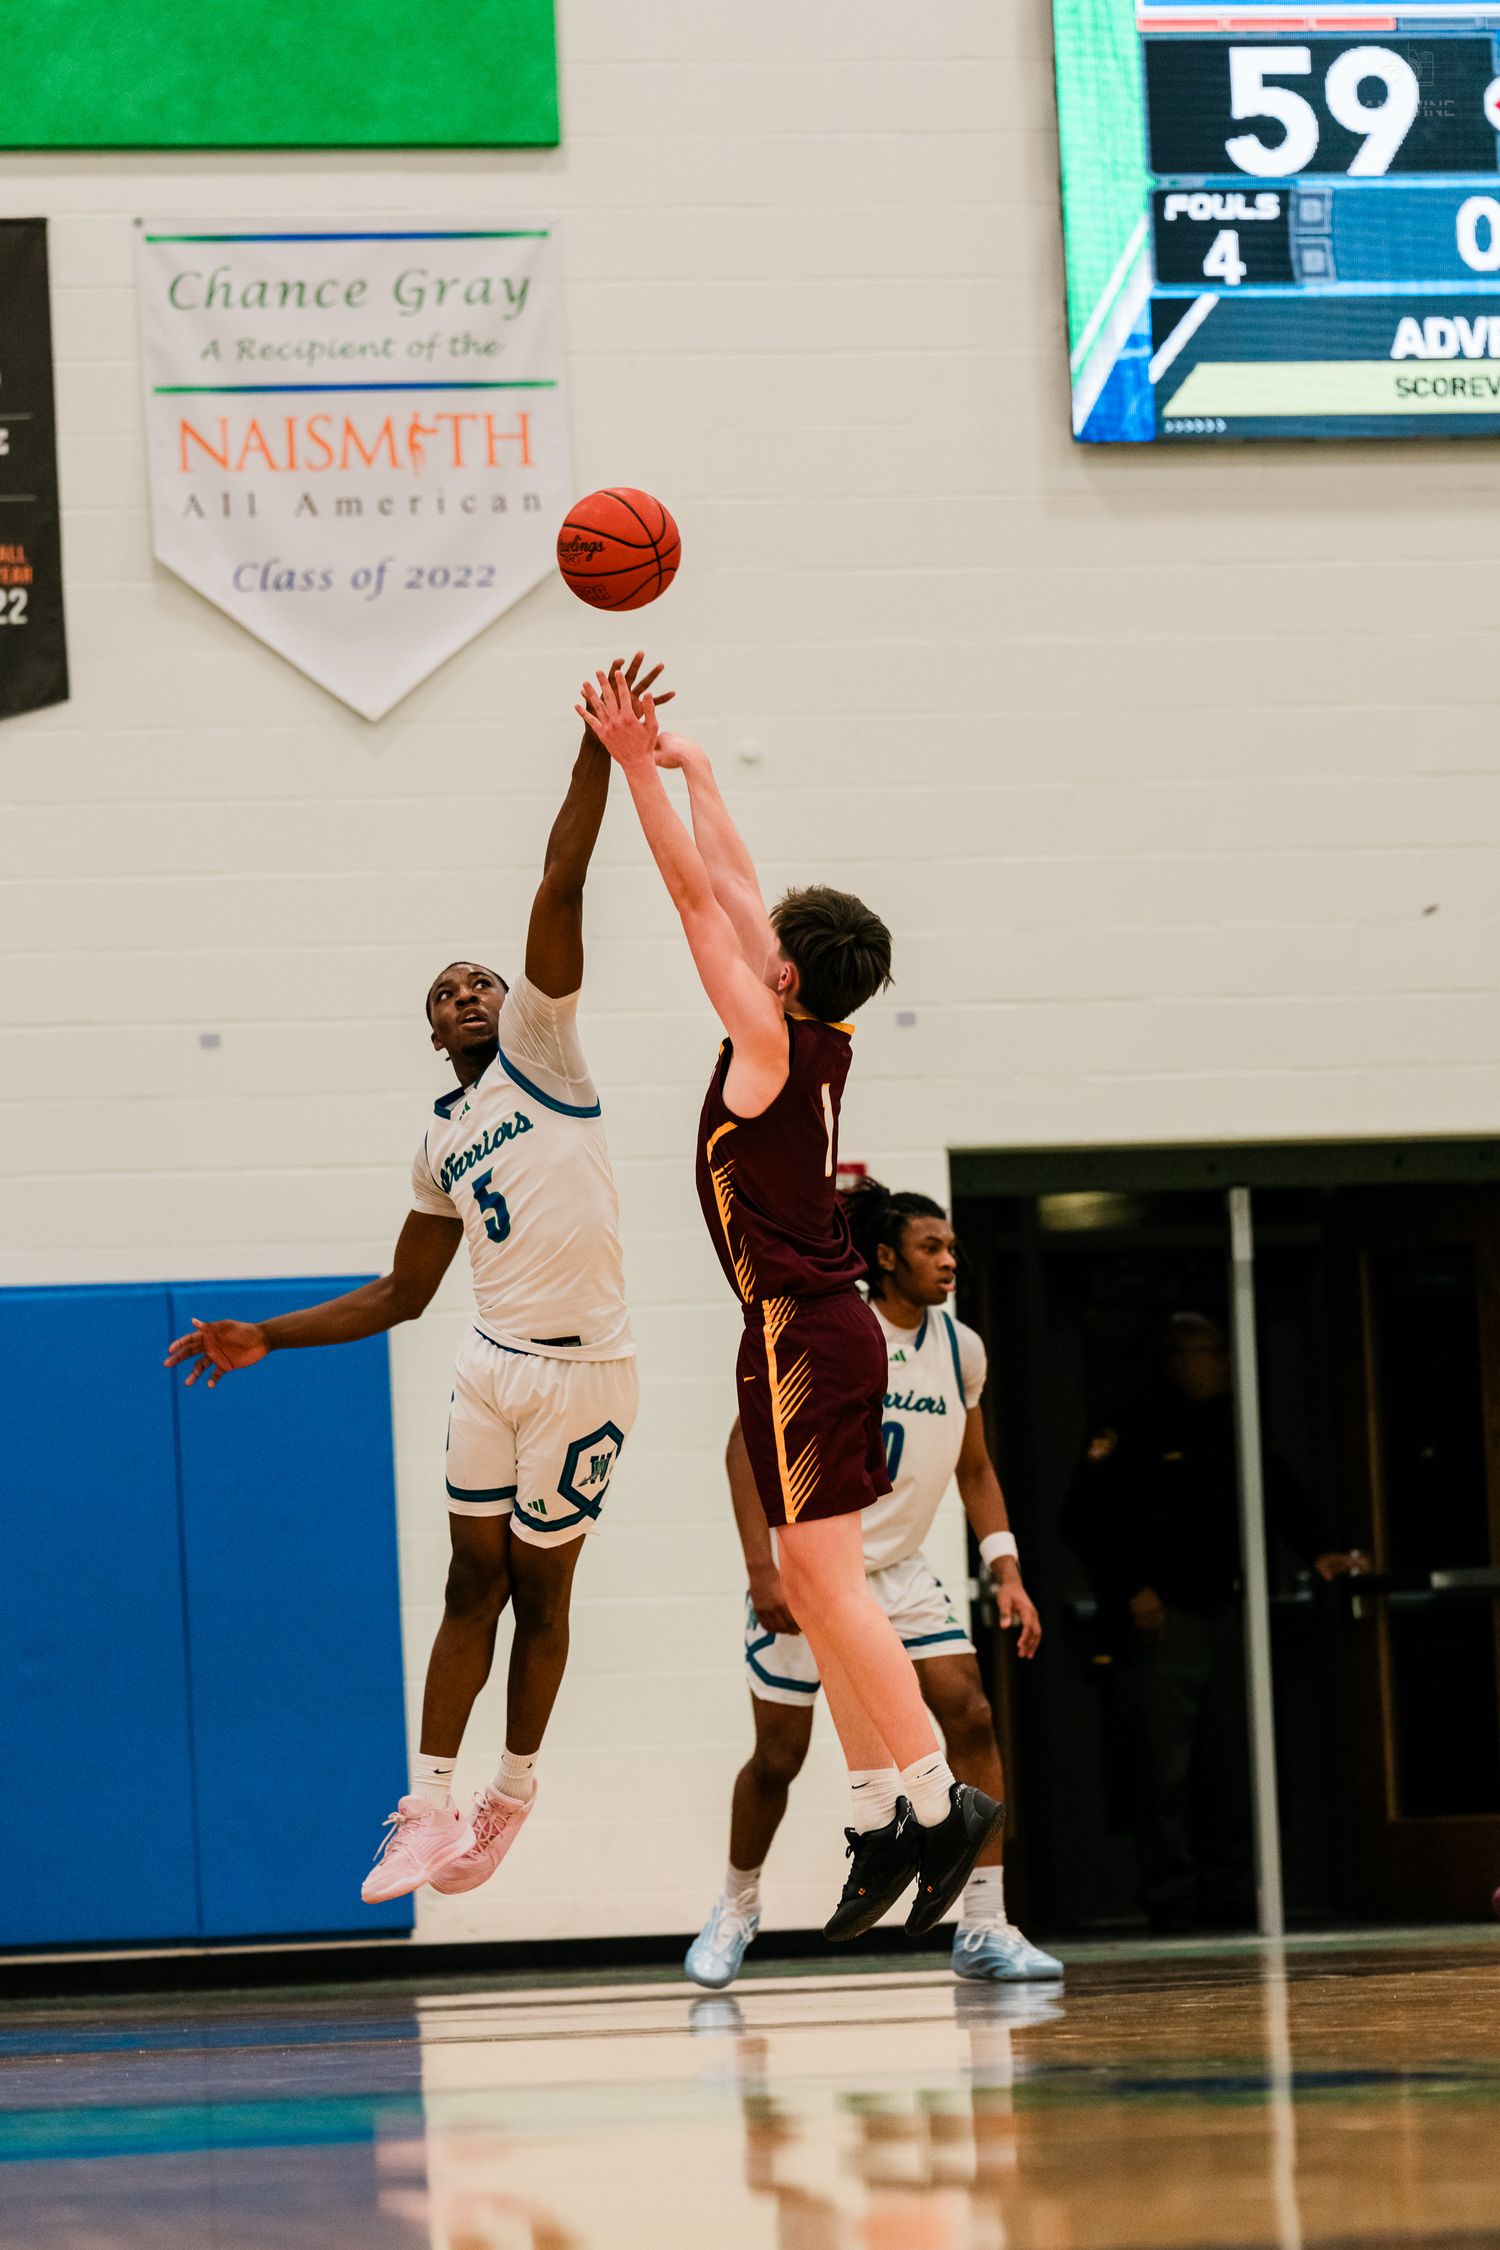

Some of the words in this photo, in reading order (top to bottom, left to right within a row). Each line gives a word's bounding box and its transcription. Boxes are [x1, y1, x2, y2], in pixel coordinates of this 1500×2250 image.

[1225, 45, 1420, 177] 59
[1163, 194, 1281, 221] FOULS
[1202, 229, 1248, 286] 4
[168, 264, 369, 311] Chance
[393, 268, 531, 322] Gray
[200, 337, 222, 363] A
[234, 336, 395, 368] Recipient
[405, 331, 442, 364] of
[448, 330, 503, 359] the
[182, 488, 257, 519] All
[294, 487, 543, 519] American
[232, 556, 335, 593] Class
[350, 554, 396, 602] of
[404, 564, 497, 590] 2022
[440, 1111, 533, 1193] Warriors
[471, 1166, 511, 1243] 5
